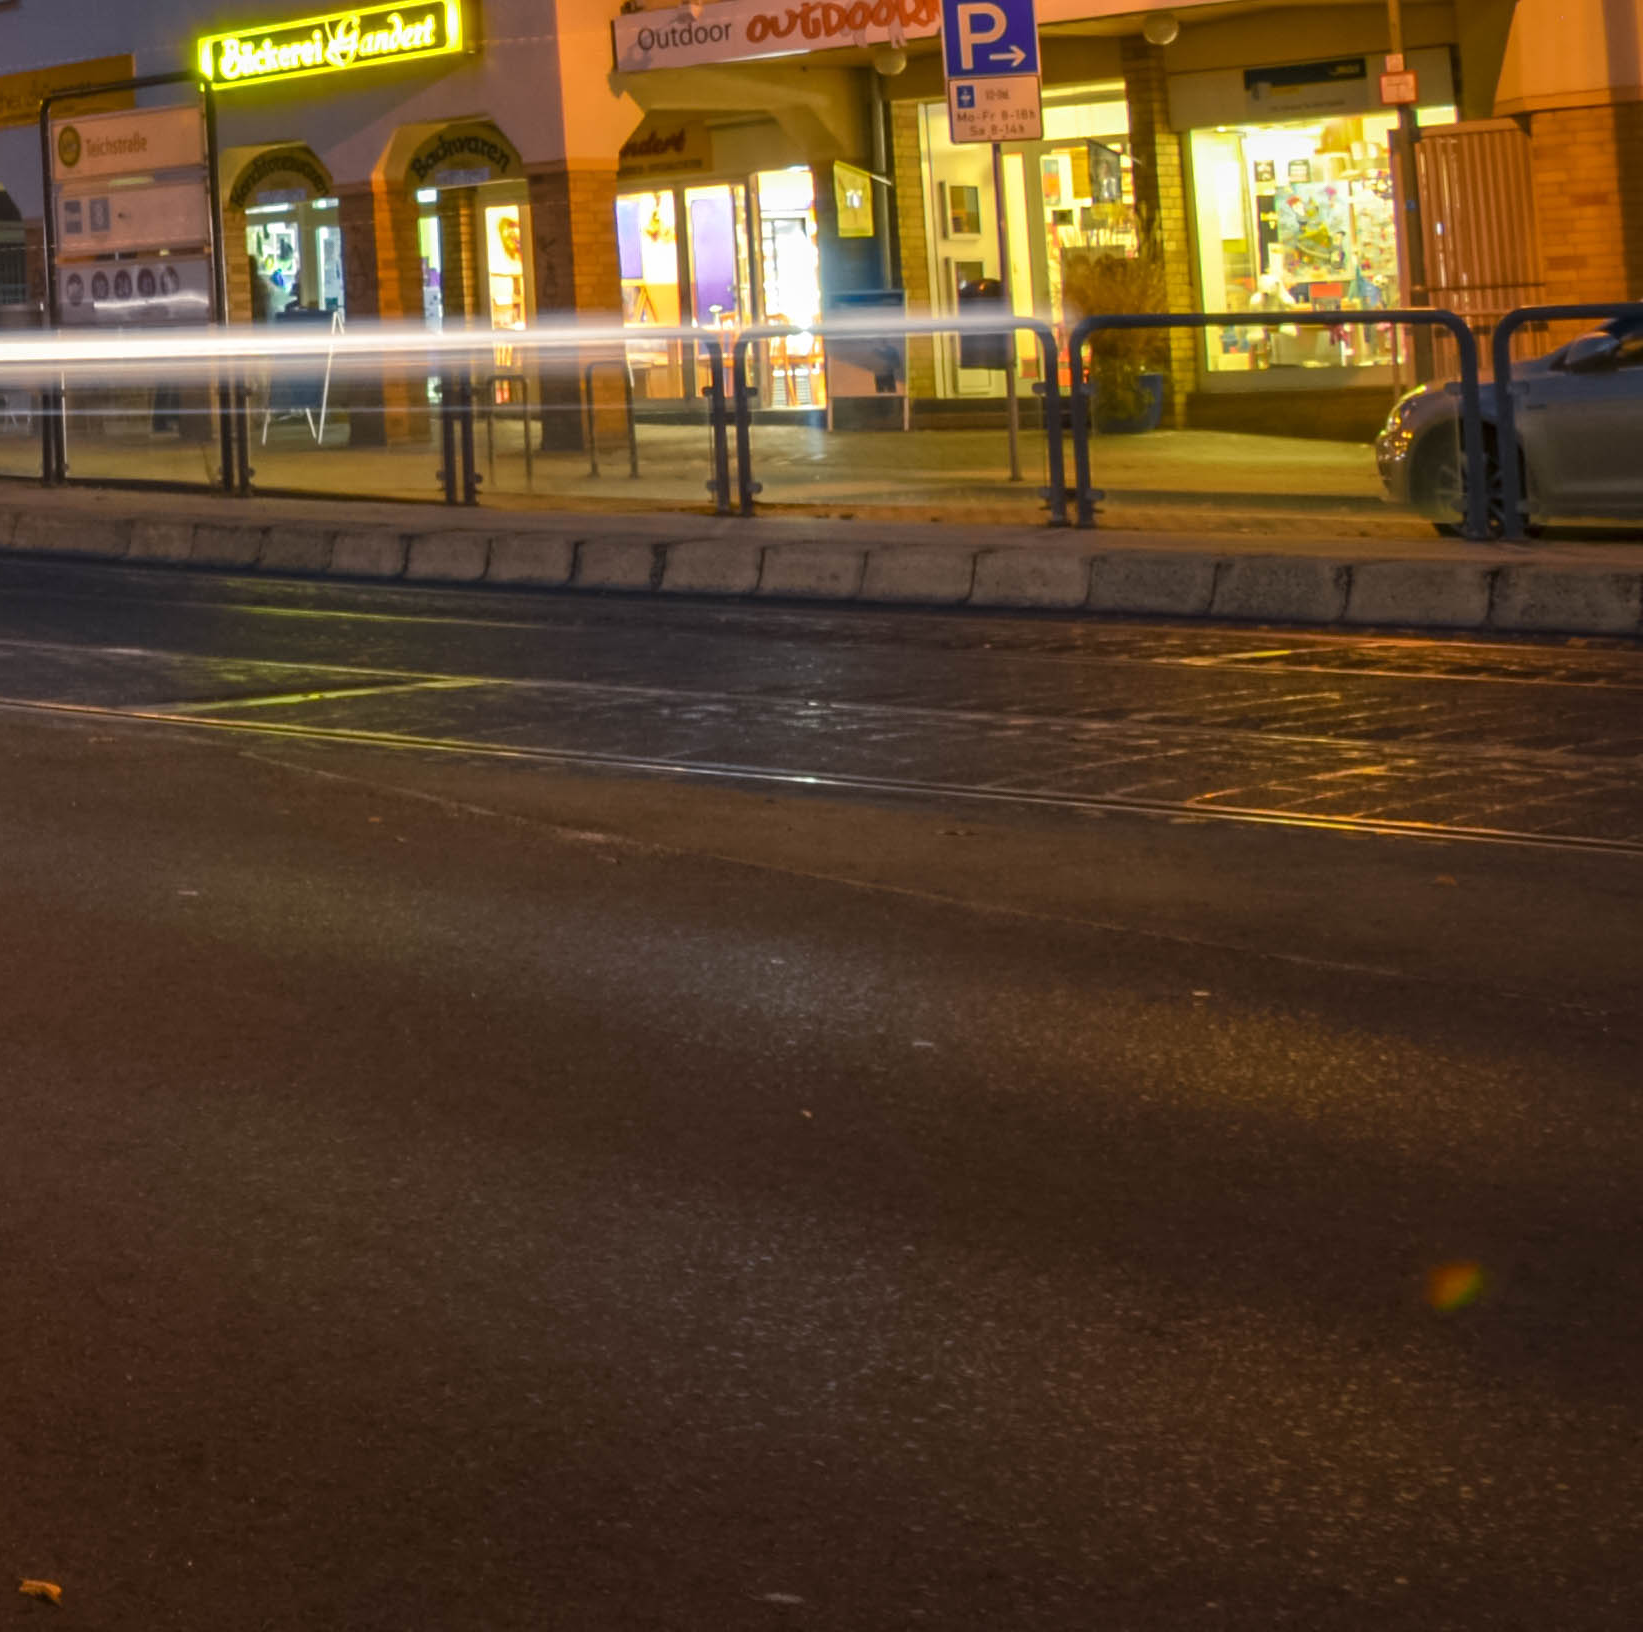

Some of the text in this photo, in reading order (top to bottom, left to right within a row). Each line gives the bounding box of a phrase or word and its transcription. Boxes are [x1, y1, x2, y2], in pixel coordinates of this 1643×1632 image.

[324, 13, 436, 68] Gandert
[638, 23, 732, 50] Outdoor
[958, 3, 1007, 70] P
[86, 132, 148, 158] Teichstraße
